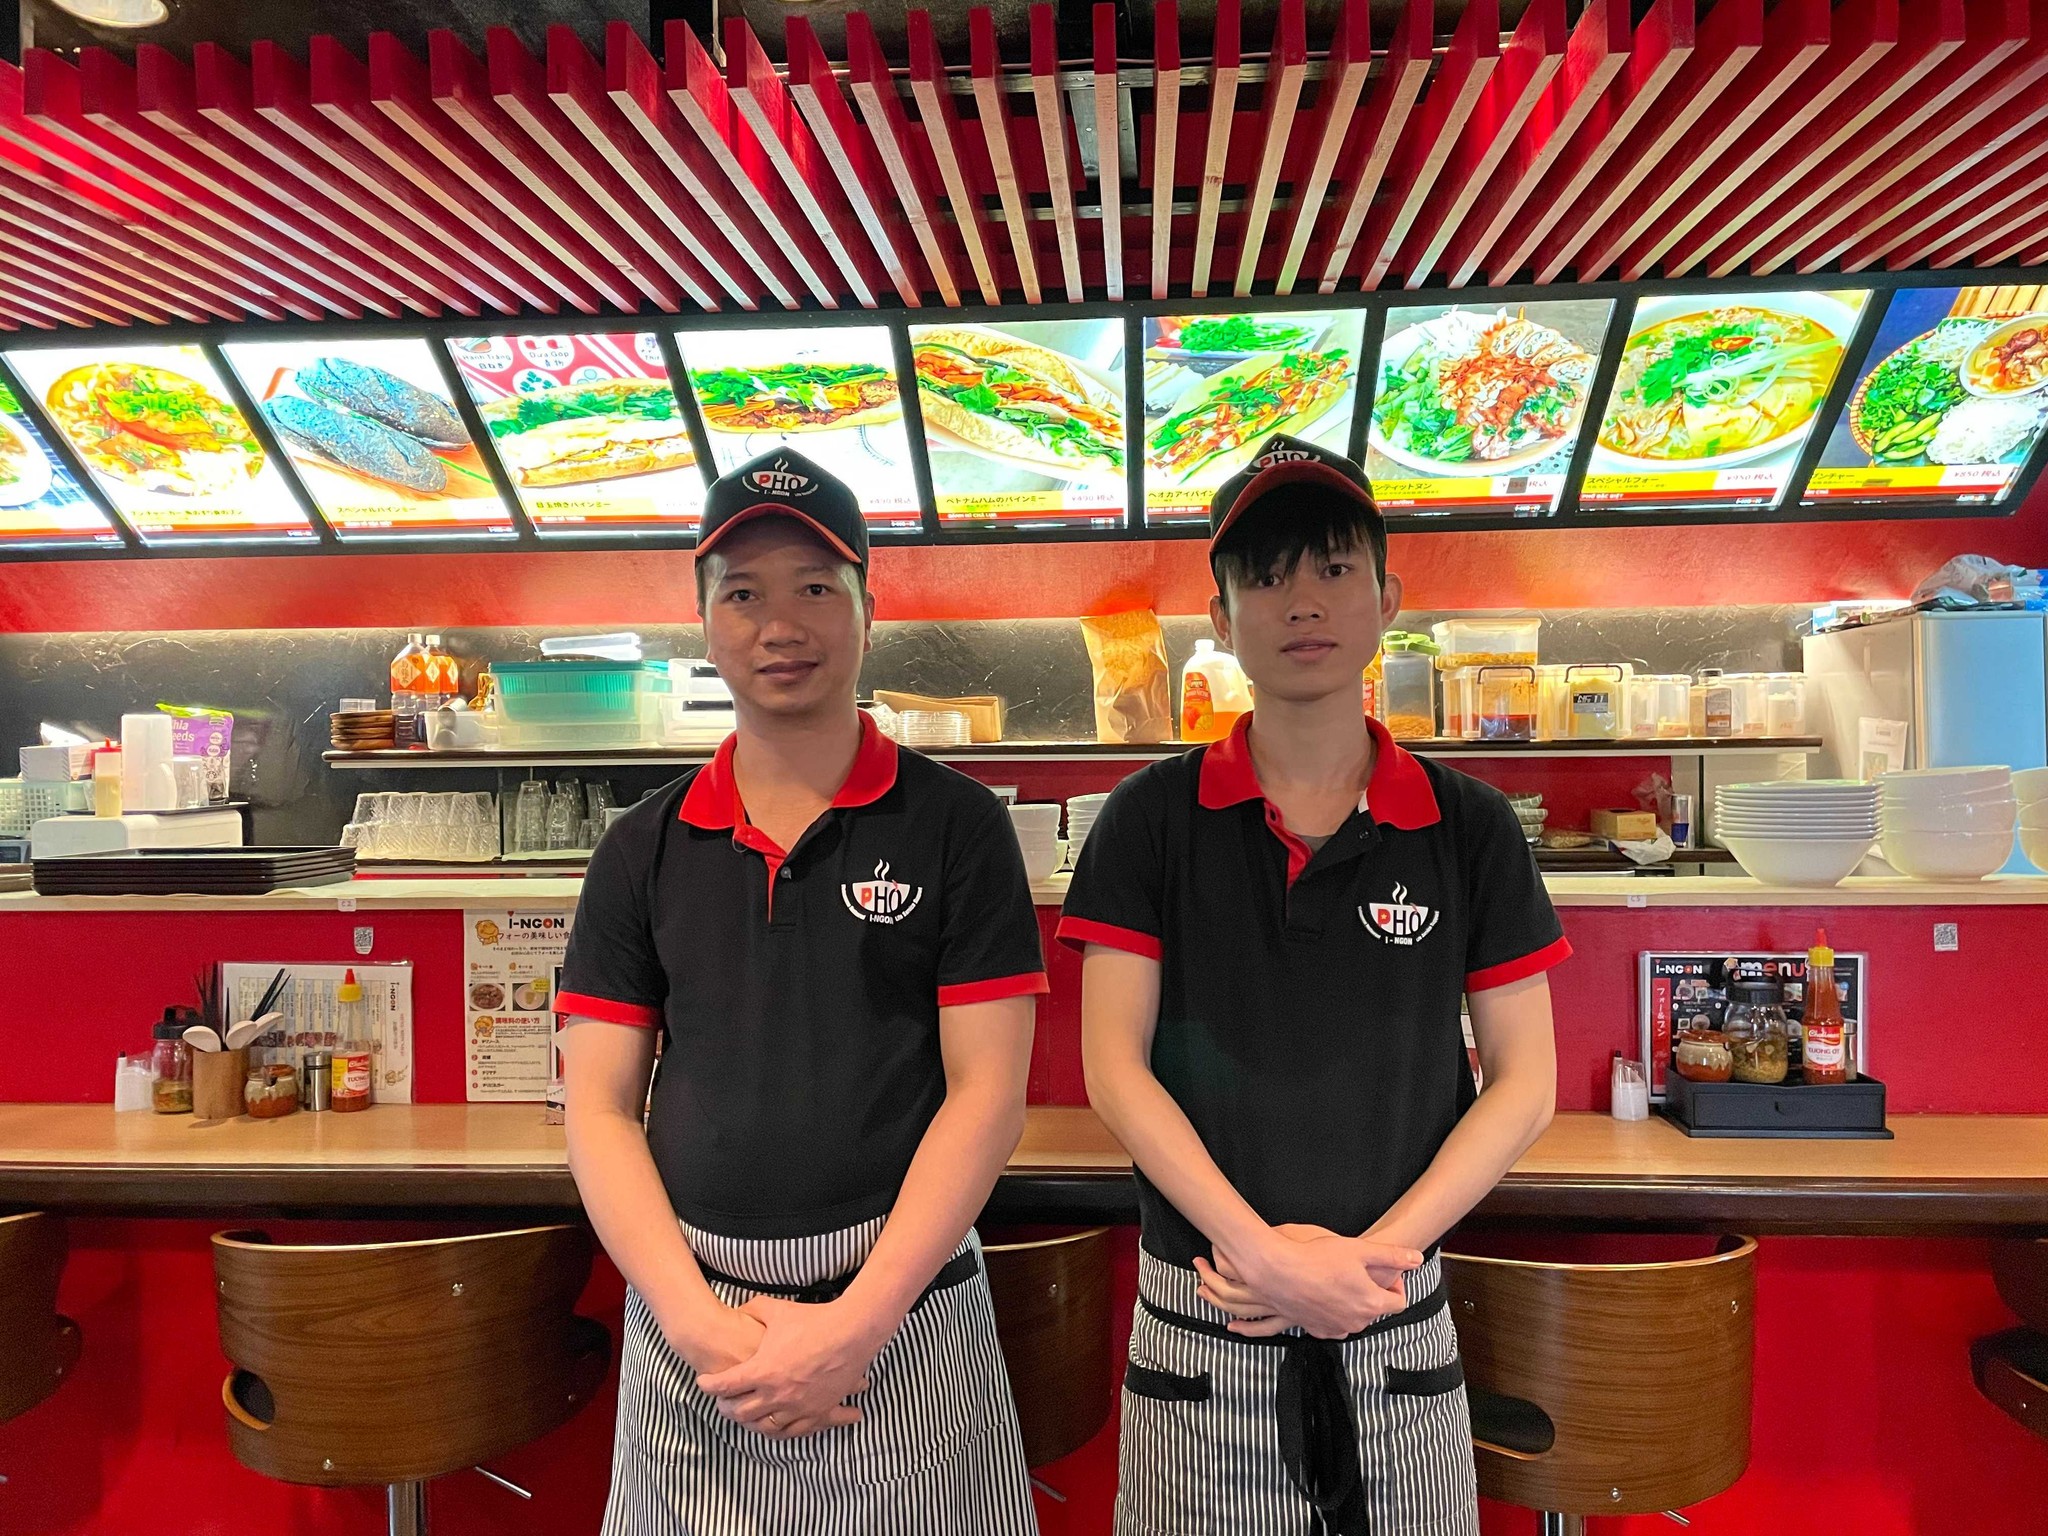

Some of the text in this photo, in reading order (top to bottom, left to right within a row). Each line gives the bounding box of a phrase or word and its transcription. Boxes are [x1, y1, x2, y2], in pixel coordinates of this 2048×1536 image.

[1586, 475, 1660, 485] スペシャルフォー
[173, 719, 189, 731] hia
[173, 731, 195, 742] eeds
[1740, 960, 1806, 978] menu
